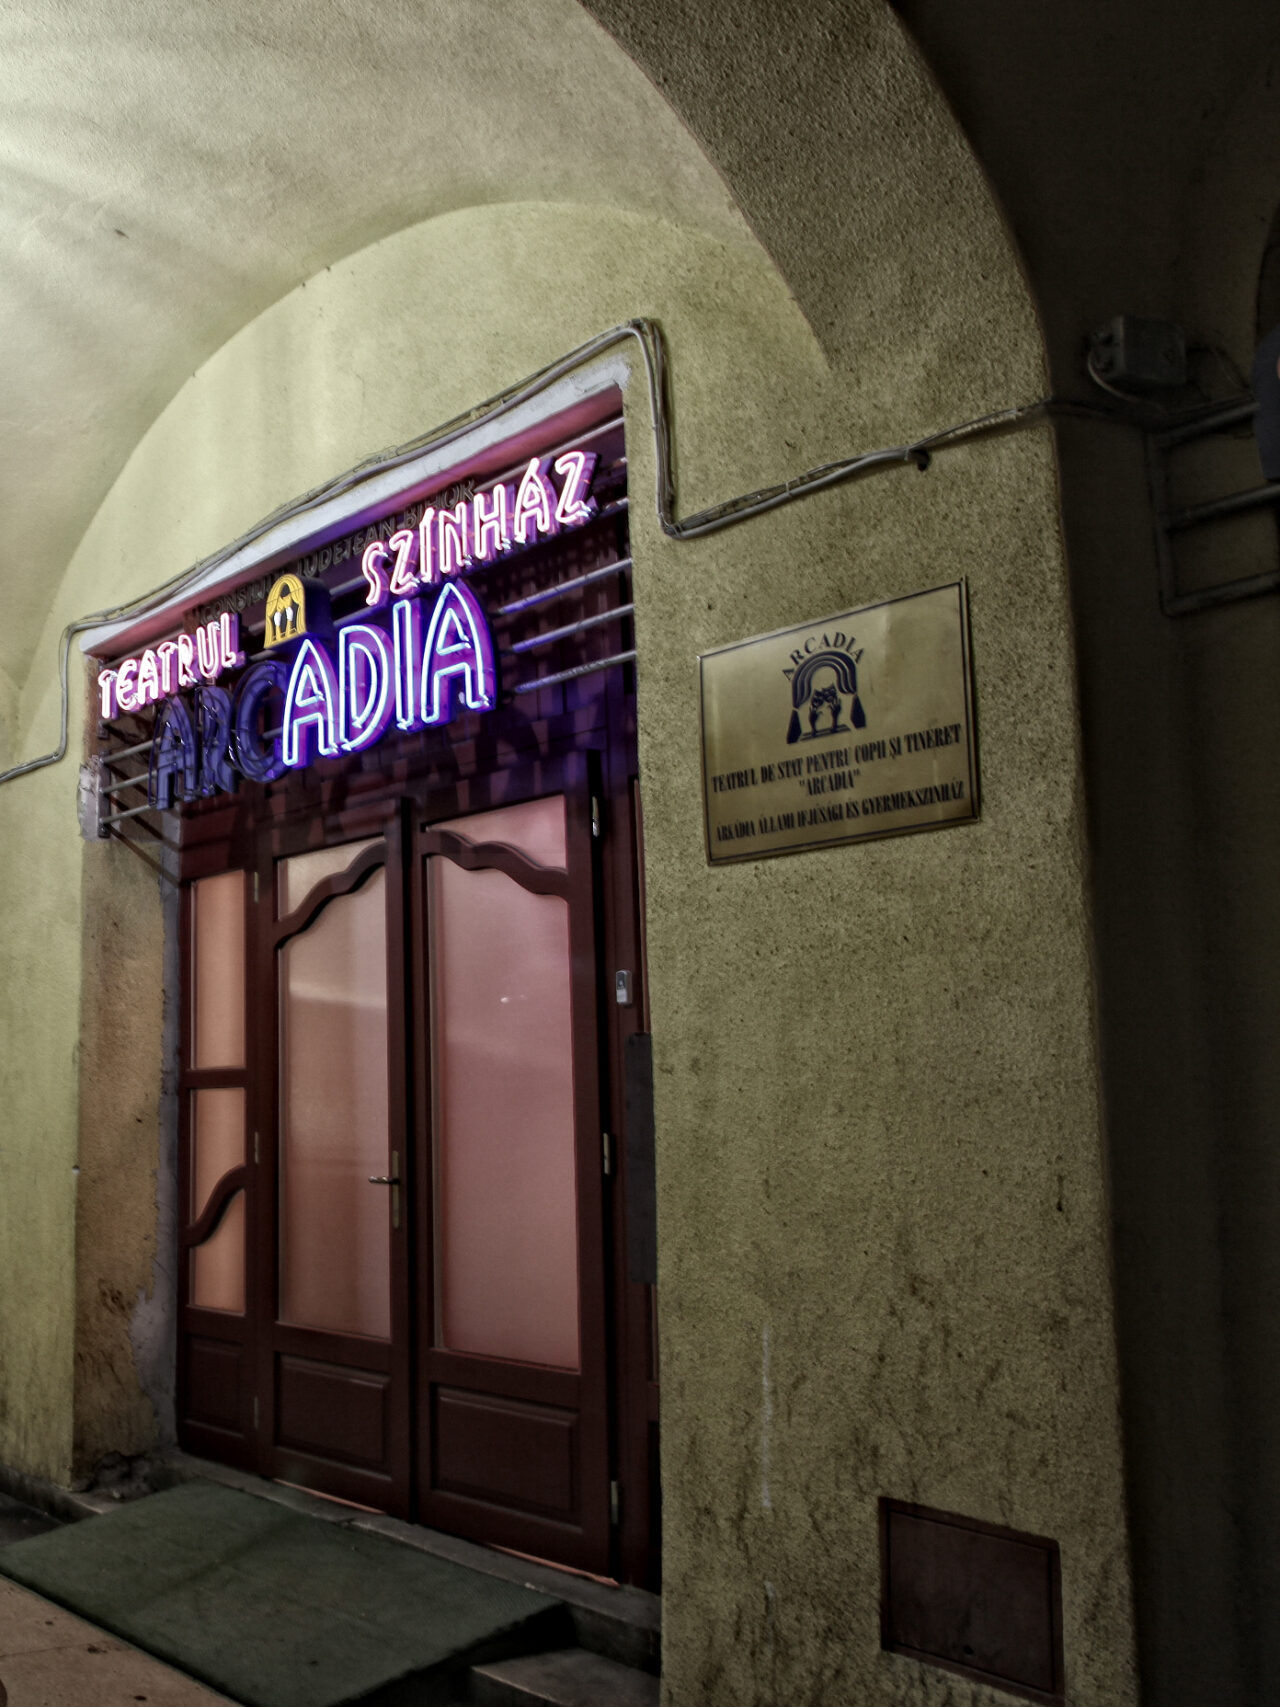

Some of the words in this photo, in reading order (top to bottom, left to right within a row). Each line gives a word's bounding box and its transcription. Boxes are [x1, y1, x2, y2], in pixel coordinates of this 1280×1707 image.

[98, 612, 241, 718] TEATRUL
[361, 451, 597, 606] SZÍNHÁZ
[199, 570, 286, 625] CONSILI
[404, 479, 476, 529] BIHOR
[148, 580, 494, 811] ARCADIA
[782, 631, 865, 681] ARCADIA
[711, 767, 758, 794] TEATRUL
[760, 763, 776, 785] DE
[777, 757, 805, 781] STAT
[806, 747, 852, 775] PENTRU
[854, 739, 887, 764] COPII
[903, 722, 962, 750] TINERET
